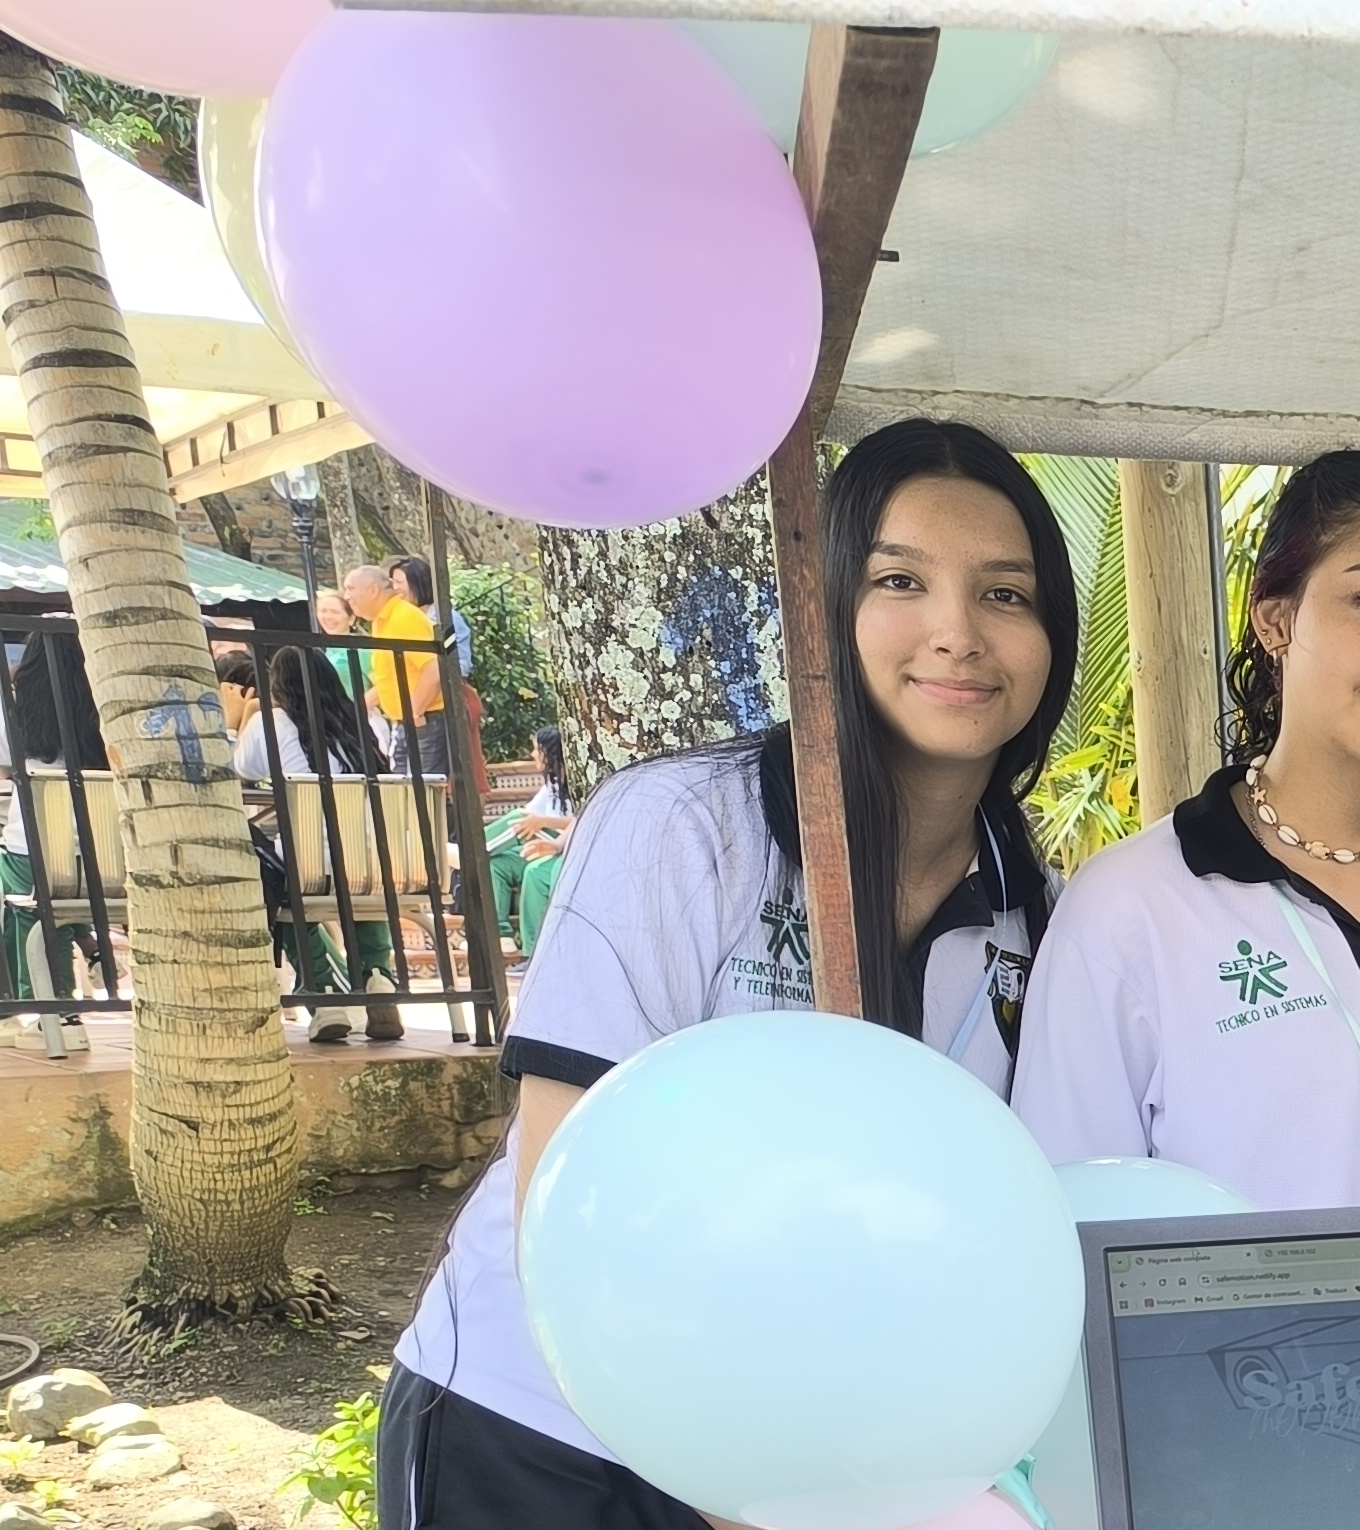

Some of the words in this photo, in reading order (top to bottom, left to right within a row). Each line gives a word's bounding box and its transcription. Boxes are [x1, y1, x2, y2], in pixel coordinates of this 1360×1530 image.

[1219, 951, 1282, 973] SENA
[734, 976, 741, 991] Y
[1216, 1010, 1260, 1033] TECNICO
[1264, 1005, 1279, 1018] EN
[1281, 995, 1327, 1013] SISTEMAS
